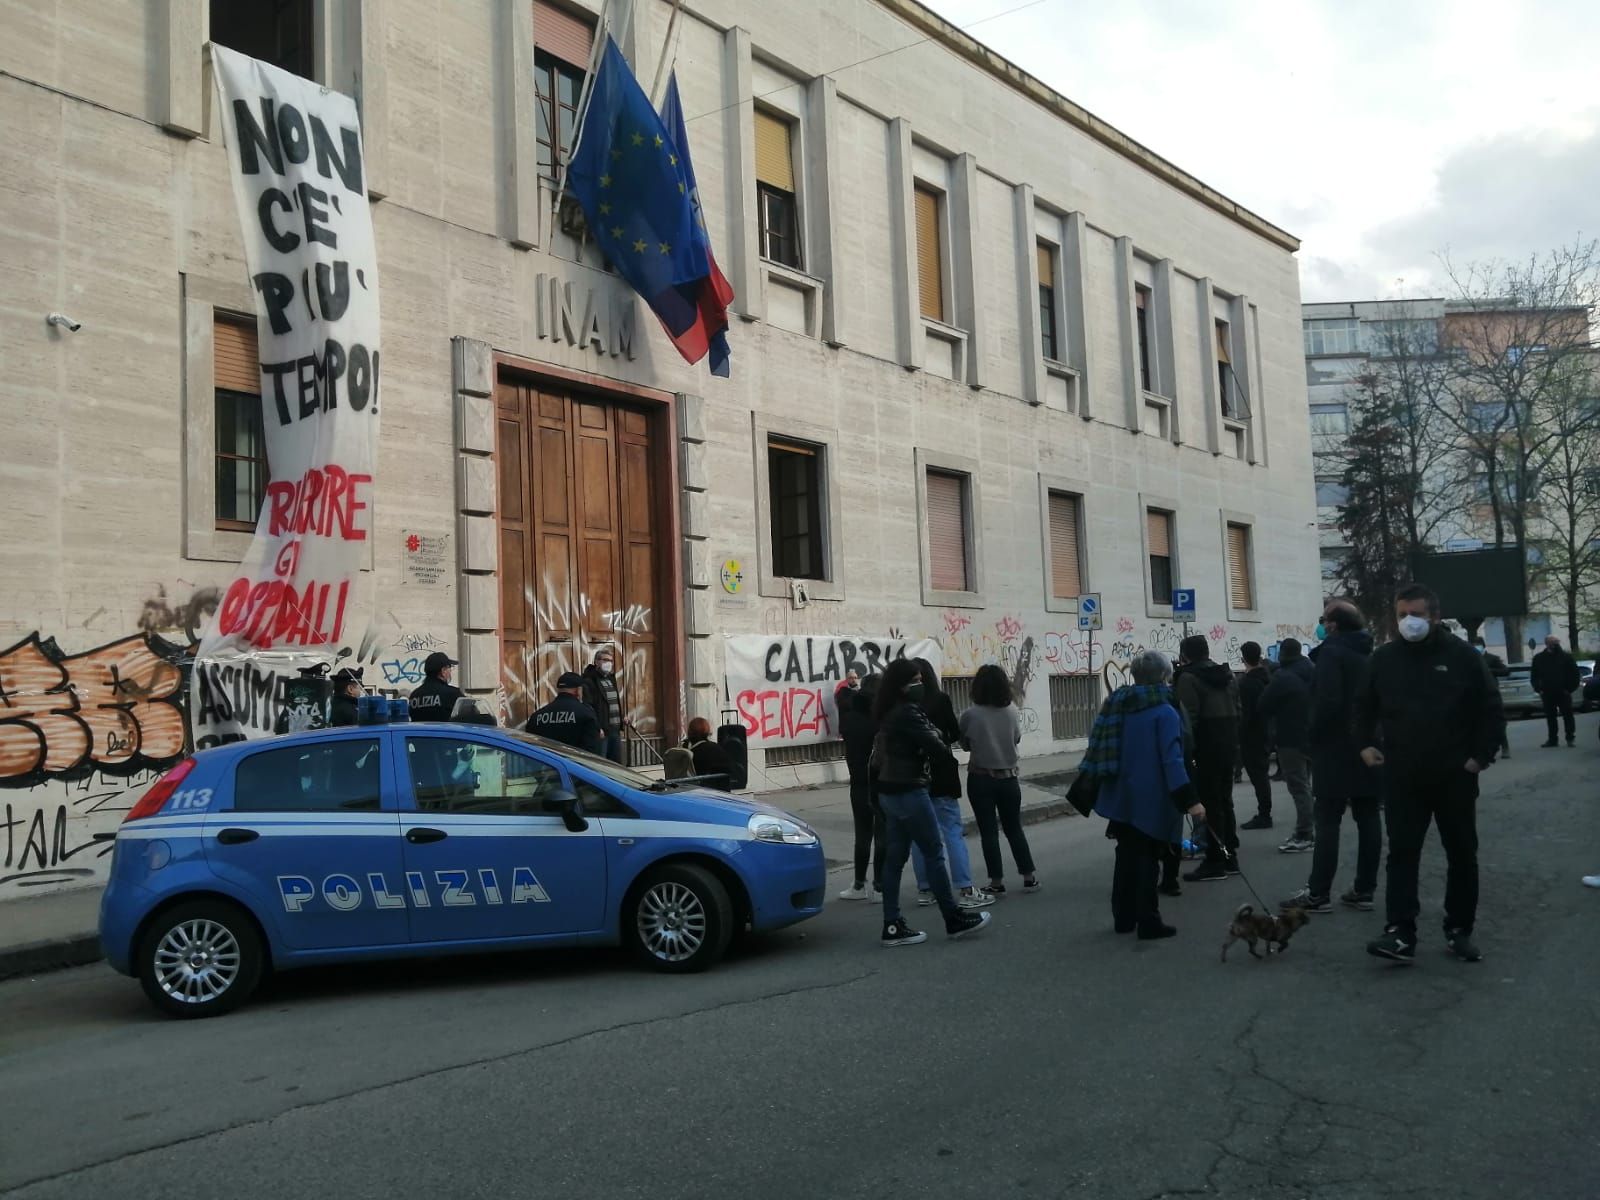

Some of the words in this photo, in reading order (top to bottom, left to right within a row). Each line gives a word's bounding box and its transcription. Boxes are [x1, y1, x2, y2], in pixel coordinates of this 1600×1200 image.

[232, 96, 363, 196] NON
[536, 273, 636, 361] INAM
[260, 338, 380, 426] TEMPO!
[1177, 592, 1189, 608] P
[536, 711, 576, 725] POLIZIA
[736, 687, 830, 739] SENZA
[171, 788, 213, 810] 113
[276, 867, 552, 912] POLIZIA
